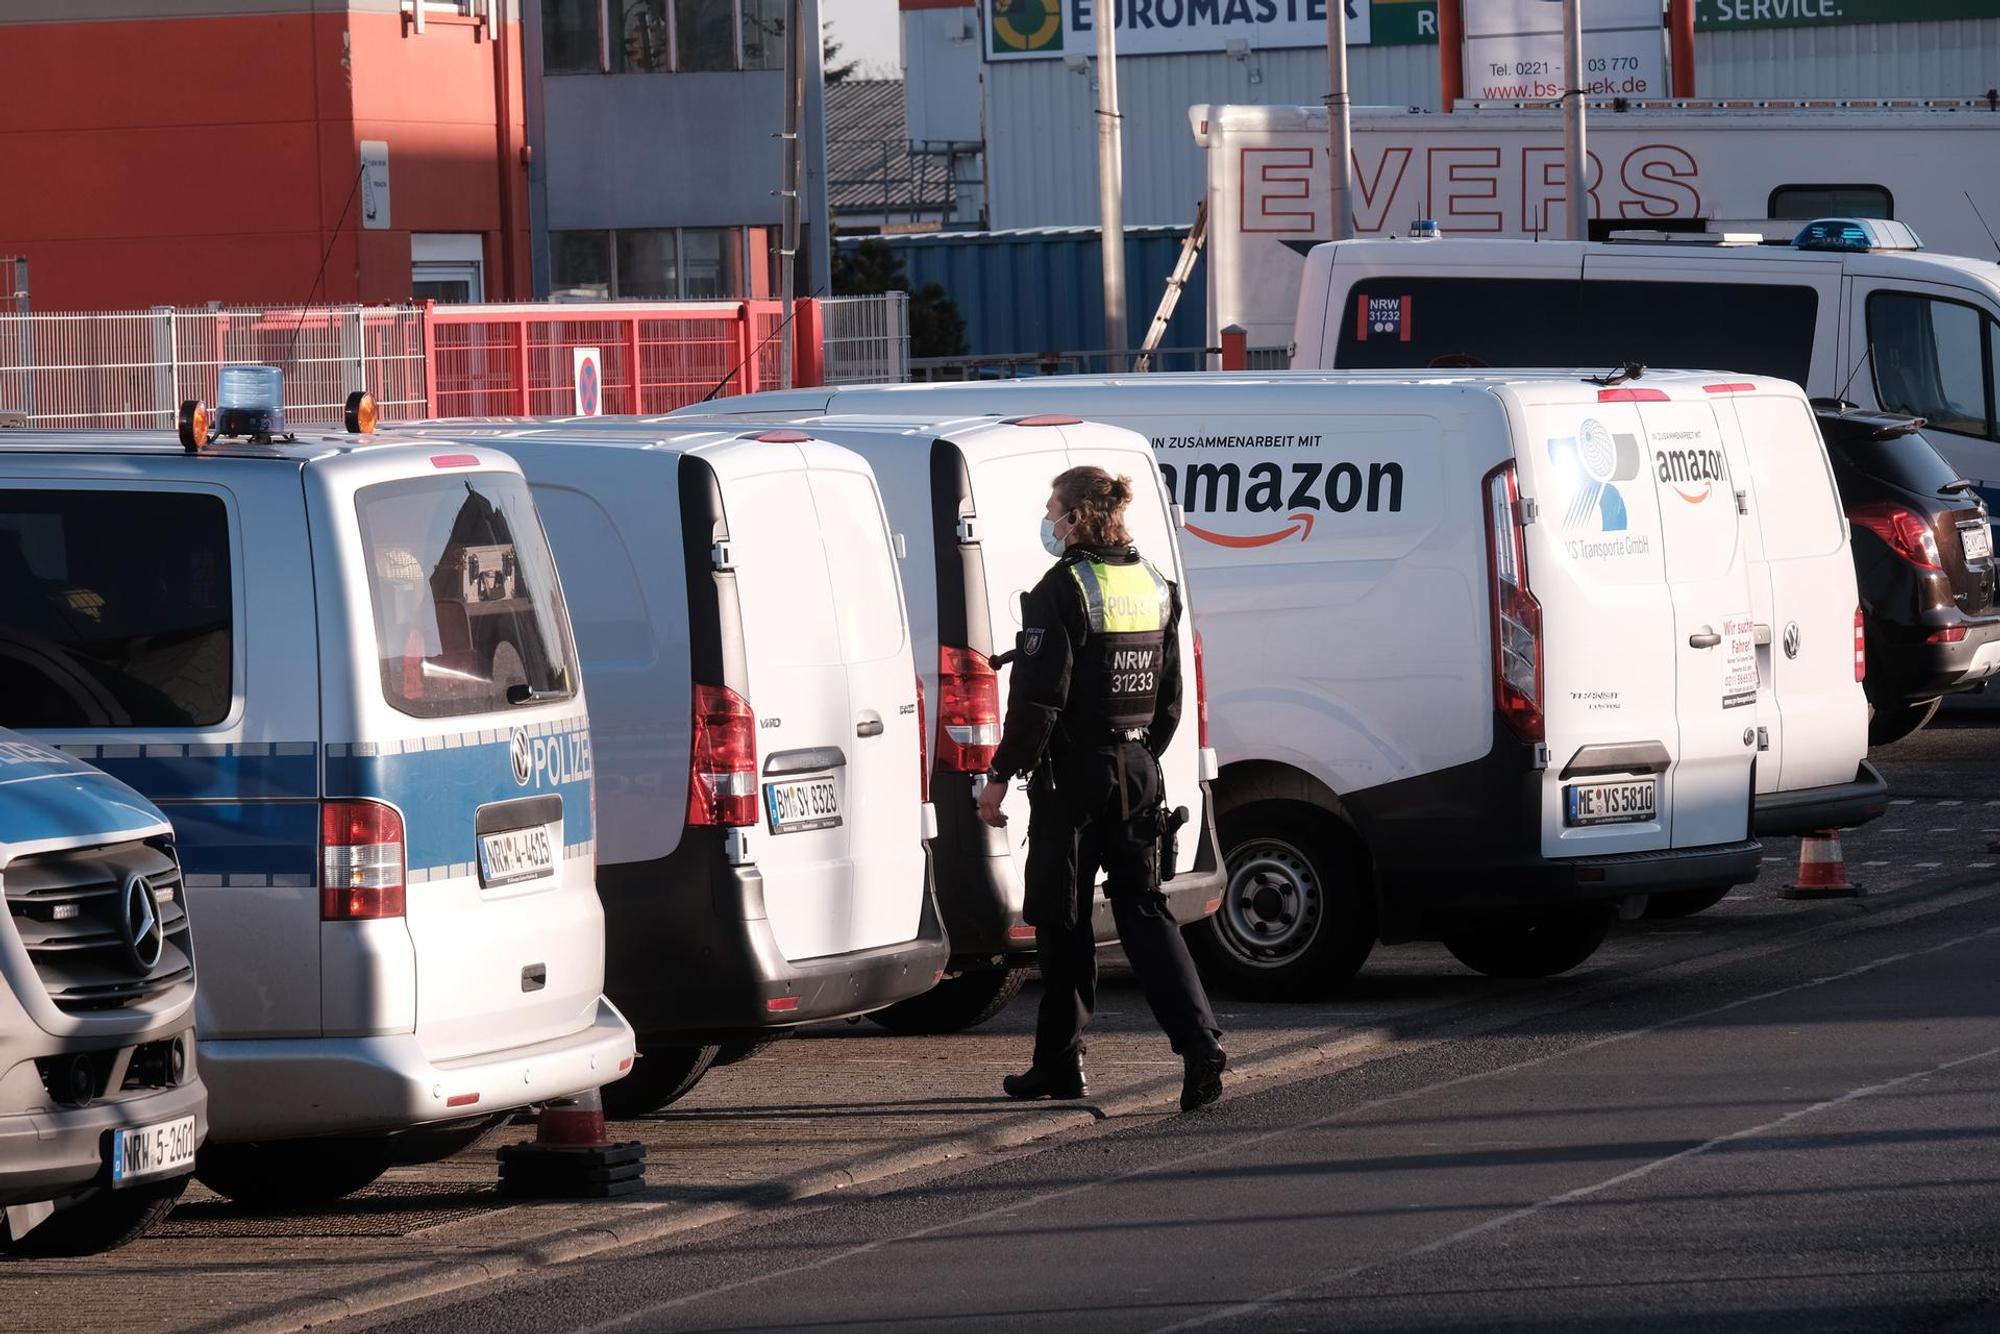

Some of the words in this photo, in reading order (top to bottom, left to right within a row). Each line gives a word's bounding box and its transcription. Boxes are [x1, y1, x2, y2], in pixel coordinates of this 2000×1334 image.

[1717, 0, 1843, 21] SERVICE.
[1489, 63, 1511, 76] Tel.
[1516, 62, 1548, 75] 0221
[1611, 56, 1638, 71] 770
[1239, 144, 1701, 233] EVERS
[1370, 299, 1400, 309] NRW
[1369, 311, 1400, 321] 31232
[1151, 437, 1165, 448] IN
[1169, 436, 1295, 448] ZUSAMMENARBEIT
[1298, 435, 1322, 447] MIT
[1656, 449, 1728, 483] amazon
[1579, 538, 1624, 560] Transporte
[1625, 536, 1649, 554] GmbH
[1114, 650, 1153, 670] NRW
[1112, 671, 1154, 693] 31233
[776, 789, 794, 819] BM
[797, 785, 810, 817] SY
[812, 783, 837, 814] 8328
[1578, 788, 1595, 815] ME
[1603, 787, 1619, 813] YS
[1621, 785, 1653, 812] 5810
[487, 837, 511, 873] NRW
[123, 1133, 150, 1173] NRW
[156, 1121, 193, 1166] 5-2601
